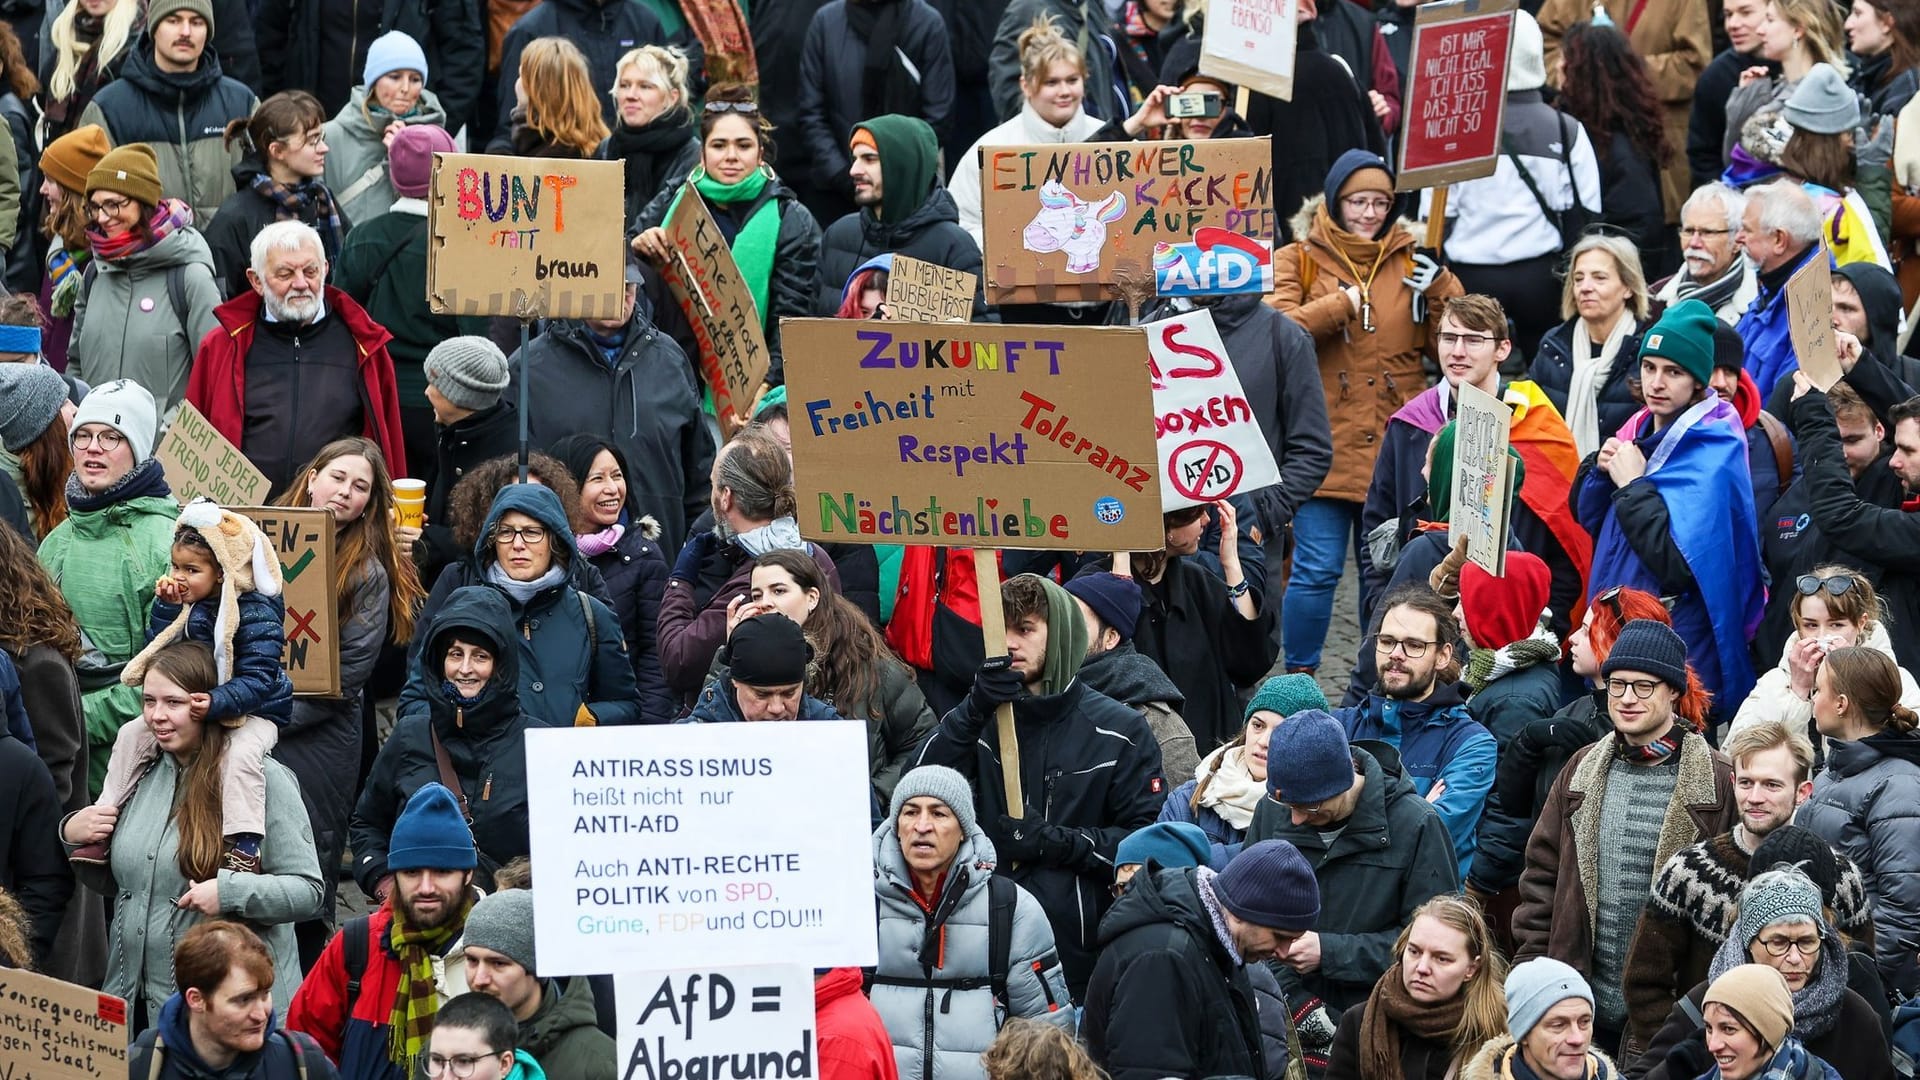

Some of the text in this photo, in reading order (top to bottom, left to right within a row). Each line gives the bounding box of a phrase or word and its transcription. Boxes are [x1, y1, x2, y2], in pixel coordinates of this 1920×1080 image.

[1231, 5, 1272, 35] EBENSO
[1440, 30, 1487, 55] IST MIR
[1425, 50, 1495, 78] NICHT EGAL,
[1430, 71, 1485, 98] ICH LASS
[1423, 90, 1488, 119] DAS JETZT
[1425, 112, 1481, 139] NICHT SO
[993, 144, 1205, 192] EINHÖRNER
[457, 168, 579, 233] BUNT
[1135, 166, 1272, 210] KACKEN
[489, 229, 540, 250] STATT
[1133, 206, 1273, 237] AUF DIE
[536, 255, 598, 280] braun
[1160, 250, 1253, 291] AfD
[696, 218, 759, 369] the most
[856, 330, 1065, 375] ZUKUNFT
[177, 405, 260, 499] NICHT JEDER
[805, 379, 1152, 493] Freiheit mit Toleranz
[168, 433, 248, 506] TREND SOLLT
[898, 432, 1029, 477] Respekt
[818, 492, 1069, 540] Nächstenliebe
[573, 786, 734, 806] heißt nicht nur
[574, 815, 679, 834] ANTI-AfD
[575, 853, 801, 878] Auch ANTI-RECHTE
[577, 882, 779, 905] POLITIK von SPD,
[577, 915, 649, 935] Grüne,
[753, 909, 823, 929] CDU!!!
[636, 973, 735, 1040] AfD
[0, 1014, 126, 1061] ntifaschismus
[623, 1029, 811, 1080] Abgrund
[42, 1042, 101, 1078] Staat,
